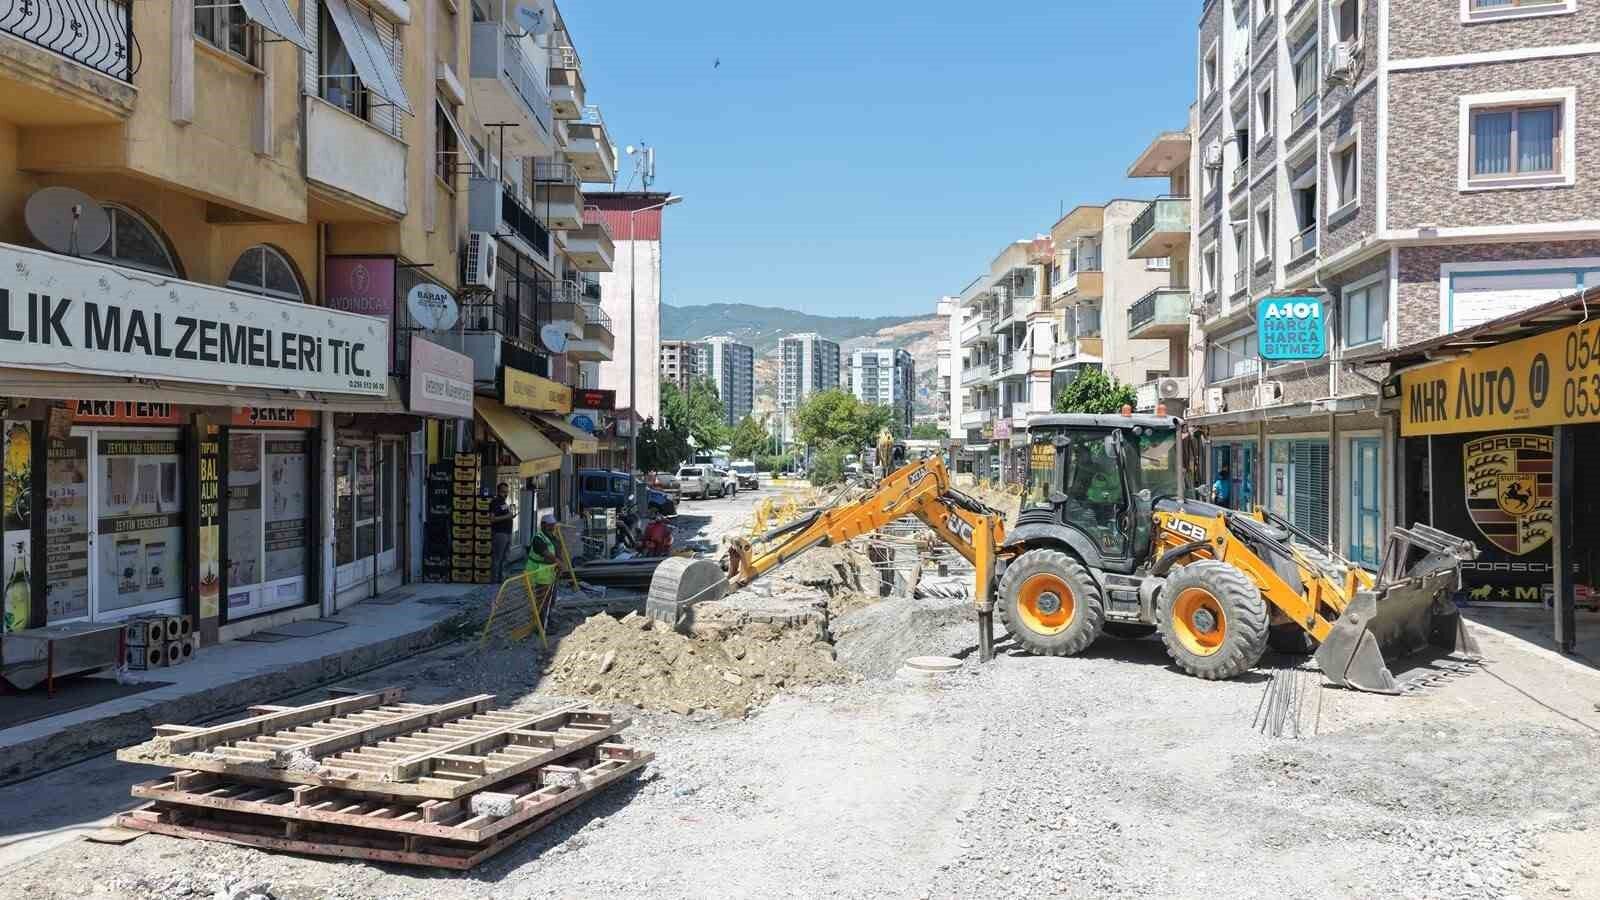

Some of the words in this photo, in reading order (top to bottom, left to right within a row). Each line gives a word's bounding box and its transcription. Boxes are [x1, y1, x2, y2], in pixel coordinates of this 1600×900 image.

[1264, 321, 1319, 331] HARCA
[1264, 332, 1320, 342] HARCA
[1410, 379, 1447, 423] MHR
[1455, 366, 1515, 419] AUTO
[1467, 437, 1552, 456] PORSCH
[201, 459, 218, 480] BAL
[201, 482, 218, 499] ALIM
[1167, 518, 1206, 541] JCB
